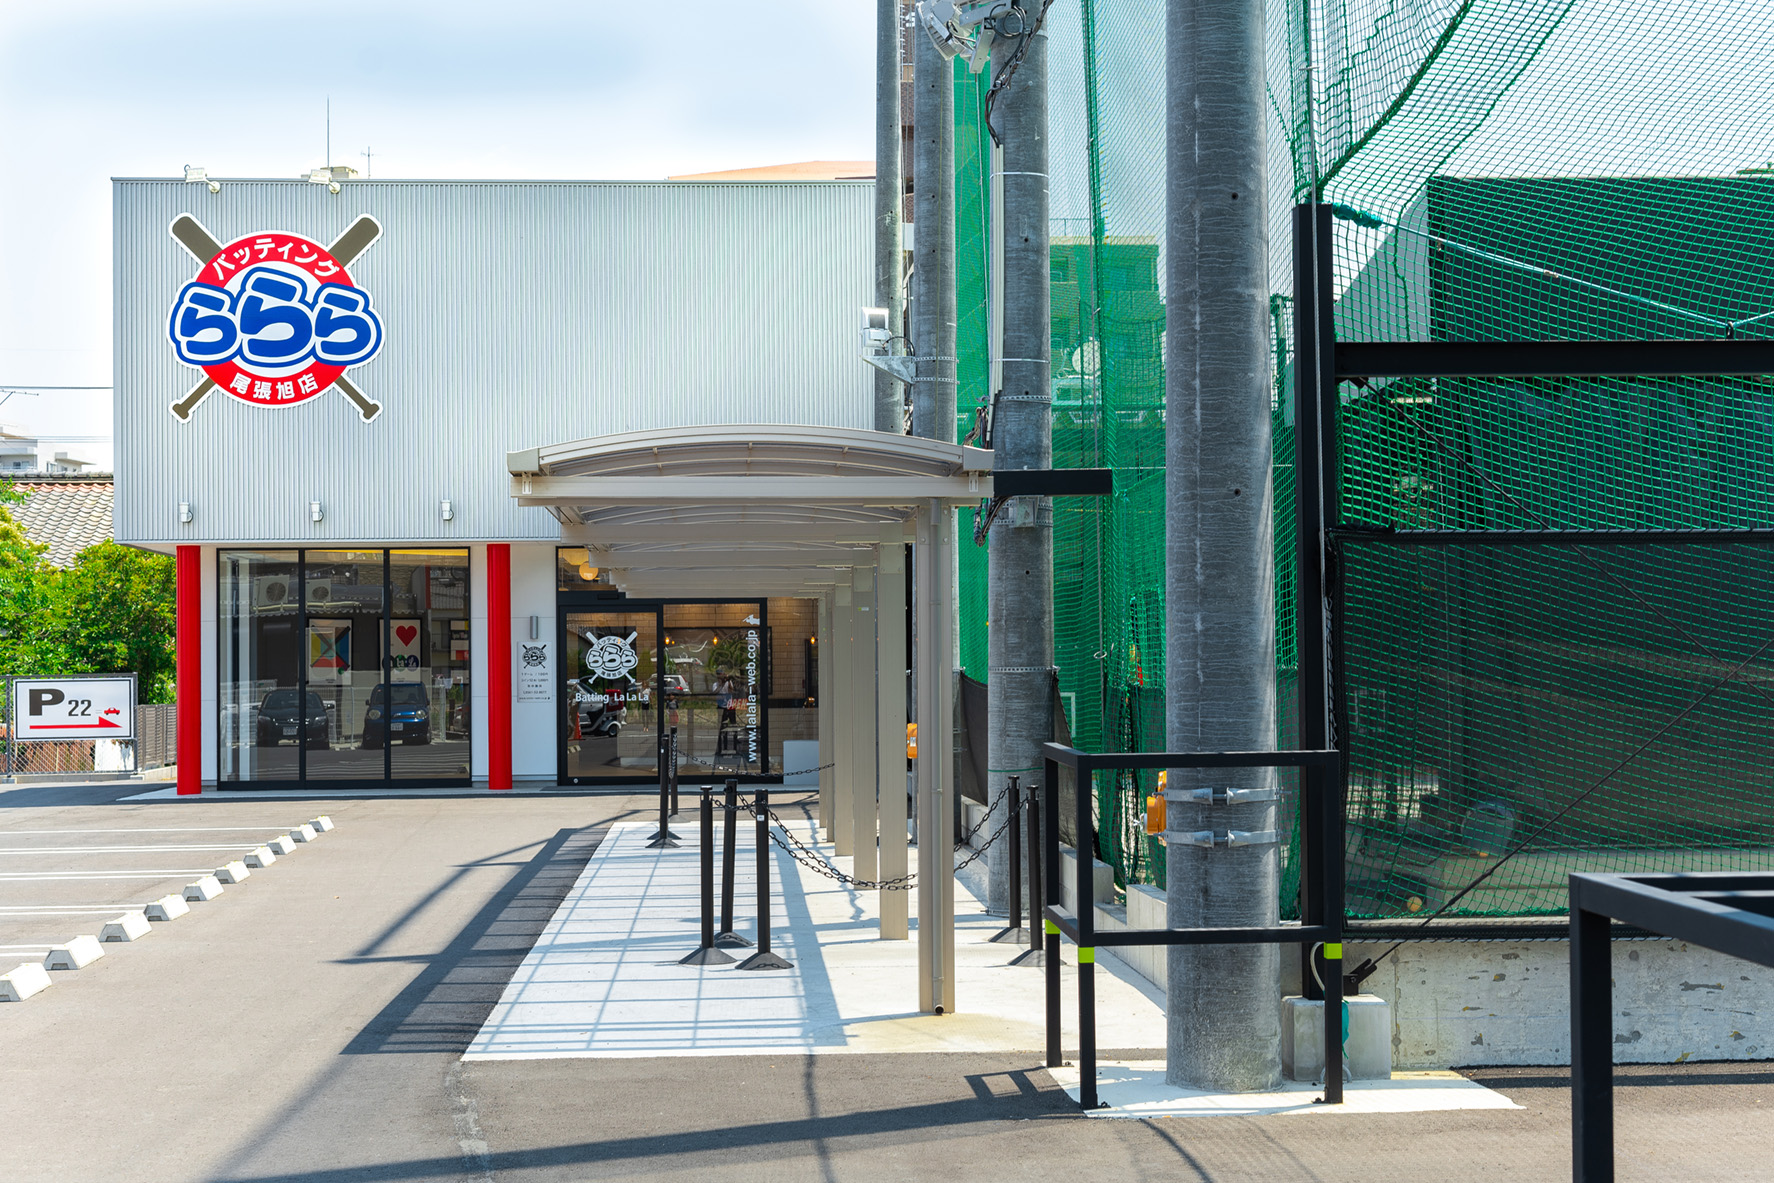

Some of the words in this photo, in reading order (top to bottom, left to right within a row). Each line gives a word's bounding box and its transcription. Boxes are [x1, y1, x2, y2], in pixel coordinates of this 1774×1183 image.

[212, 238, 340, 281] バッティング
[175, 272, 377, 363] ららら
[229, 372, 319, 401] 尾張旭店
[588, 646, 636, 670] ららら
[29, 688, 65, 716] P
[68, 699, 92, 717] 22
[575, 692, 609, 704] Batting
[614, 692, 625, 702] La
[626, 692, 637, 702] La
[638, 692, 649, 702] La
[745, 629, 758, 762] www.lalala-web.co.jp
